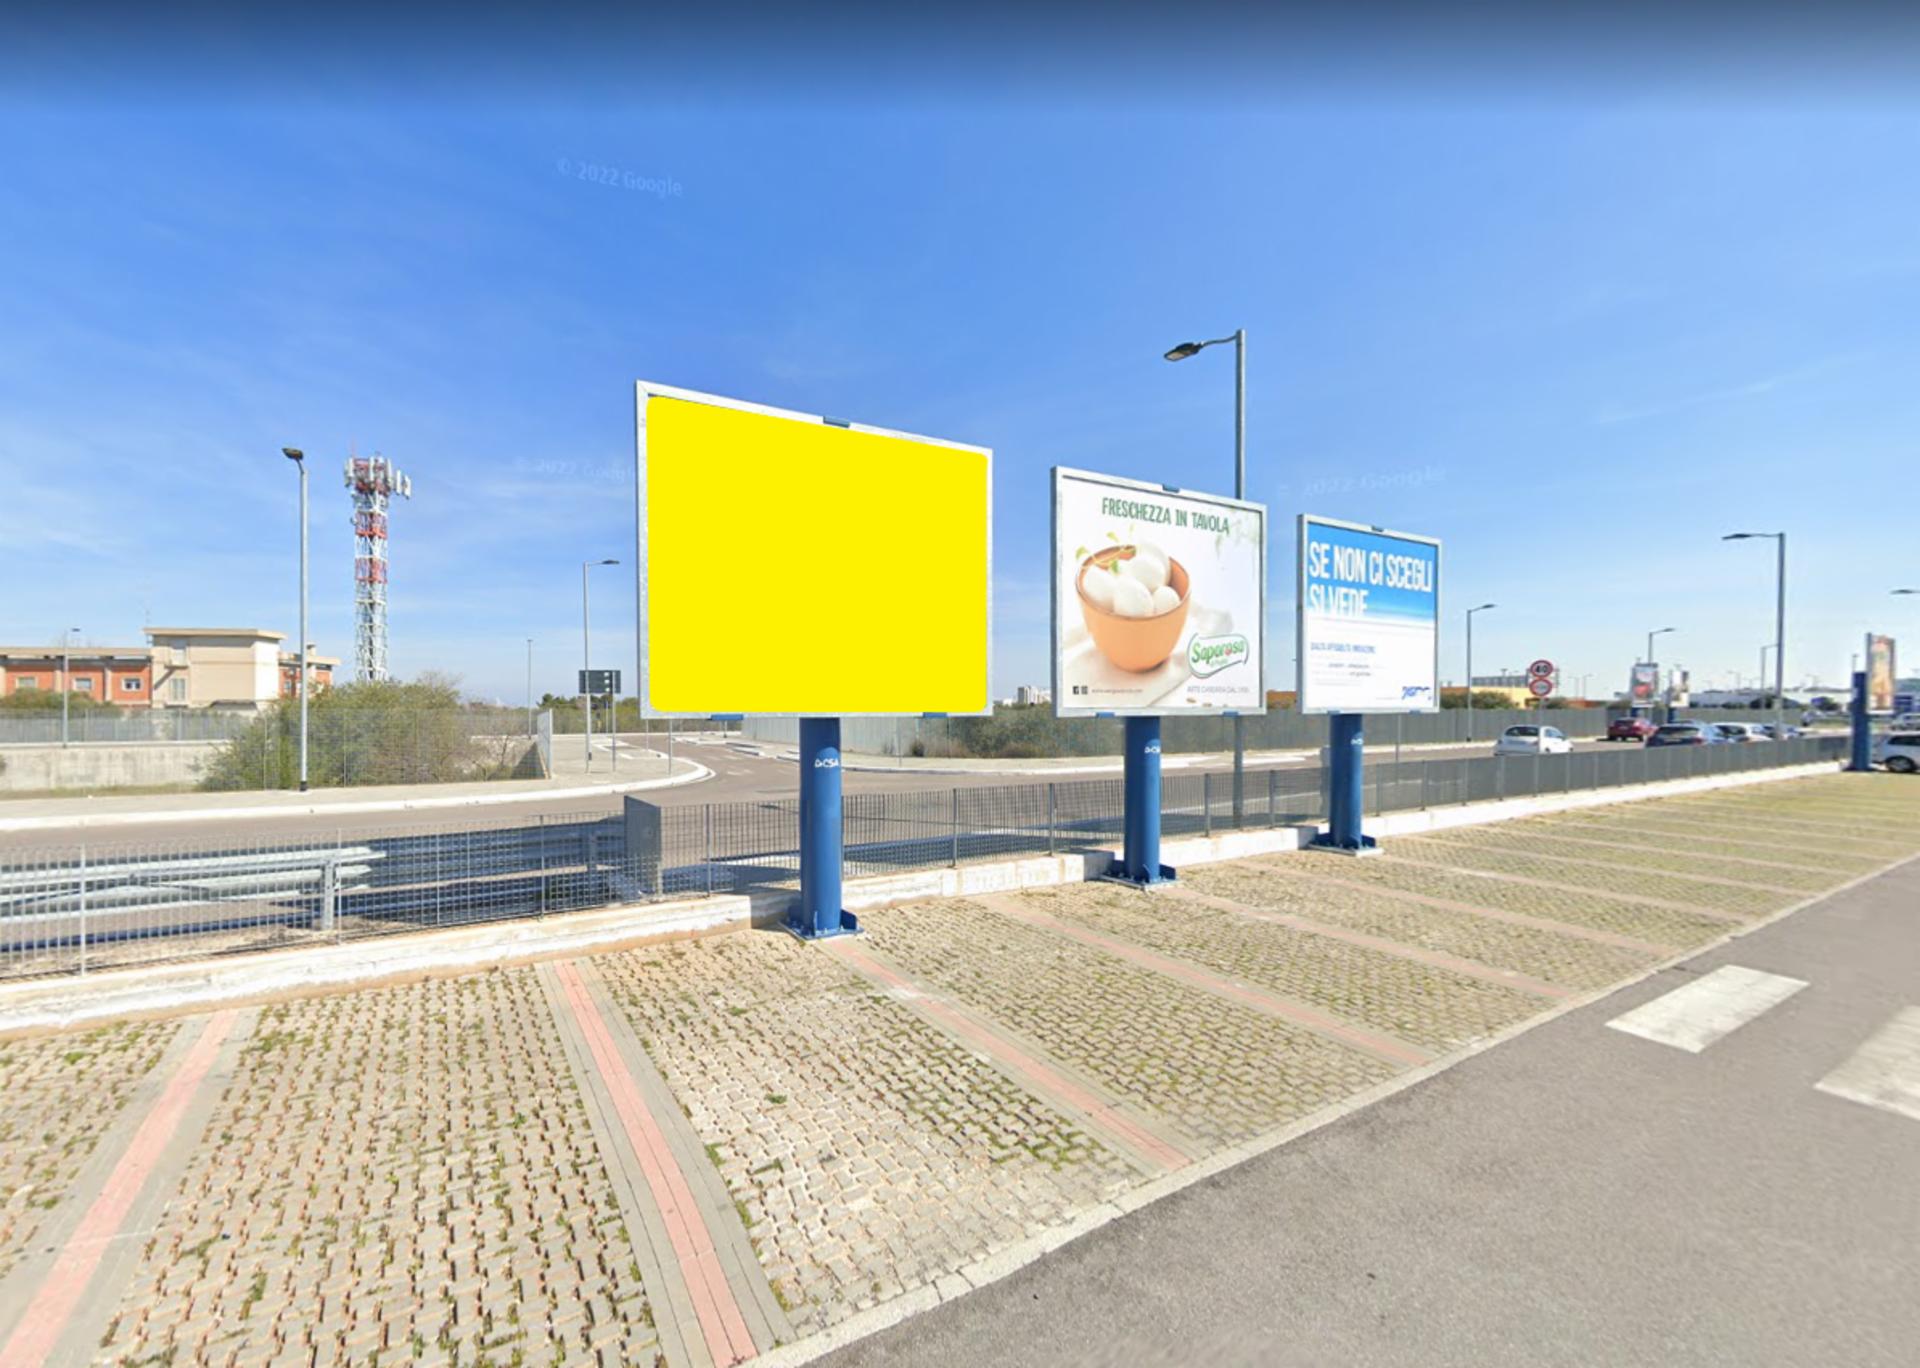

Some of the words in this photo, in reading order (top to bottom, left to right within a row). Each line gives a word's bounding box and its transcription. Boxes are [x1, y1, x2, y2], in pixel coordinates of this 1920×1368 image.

[1101, 497, 1172, 525] FRESCHEZZA
[1175, 508, 1188, 528] IN
[1191, 511, 1230, 535] TAVOLA
[1308, 540, 1331, 580] SE
[1333, 545, 1367, 584] NON
[1369, 550, 1385, 586] CI
[1386, 553, 1433, 593] SCEGLI
